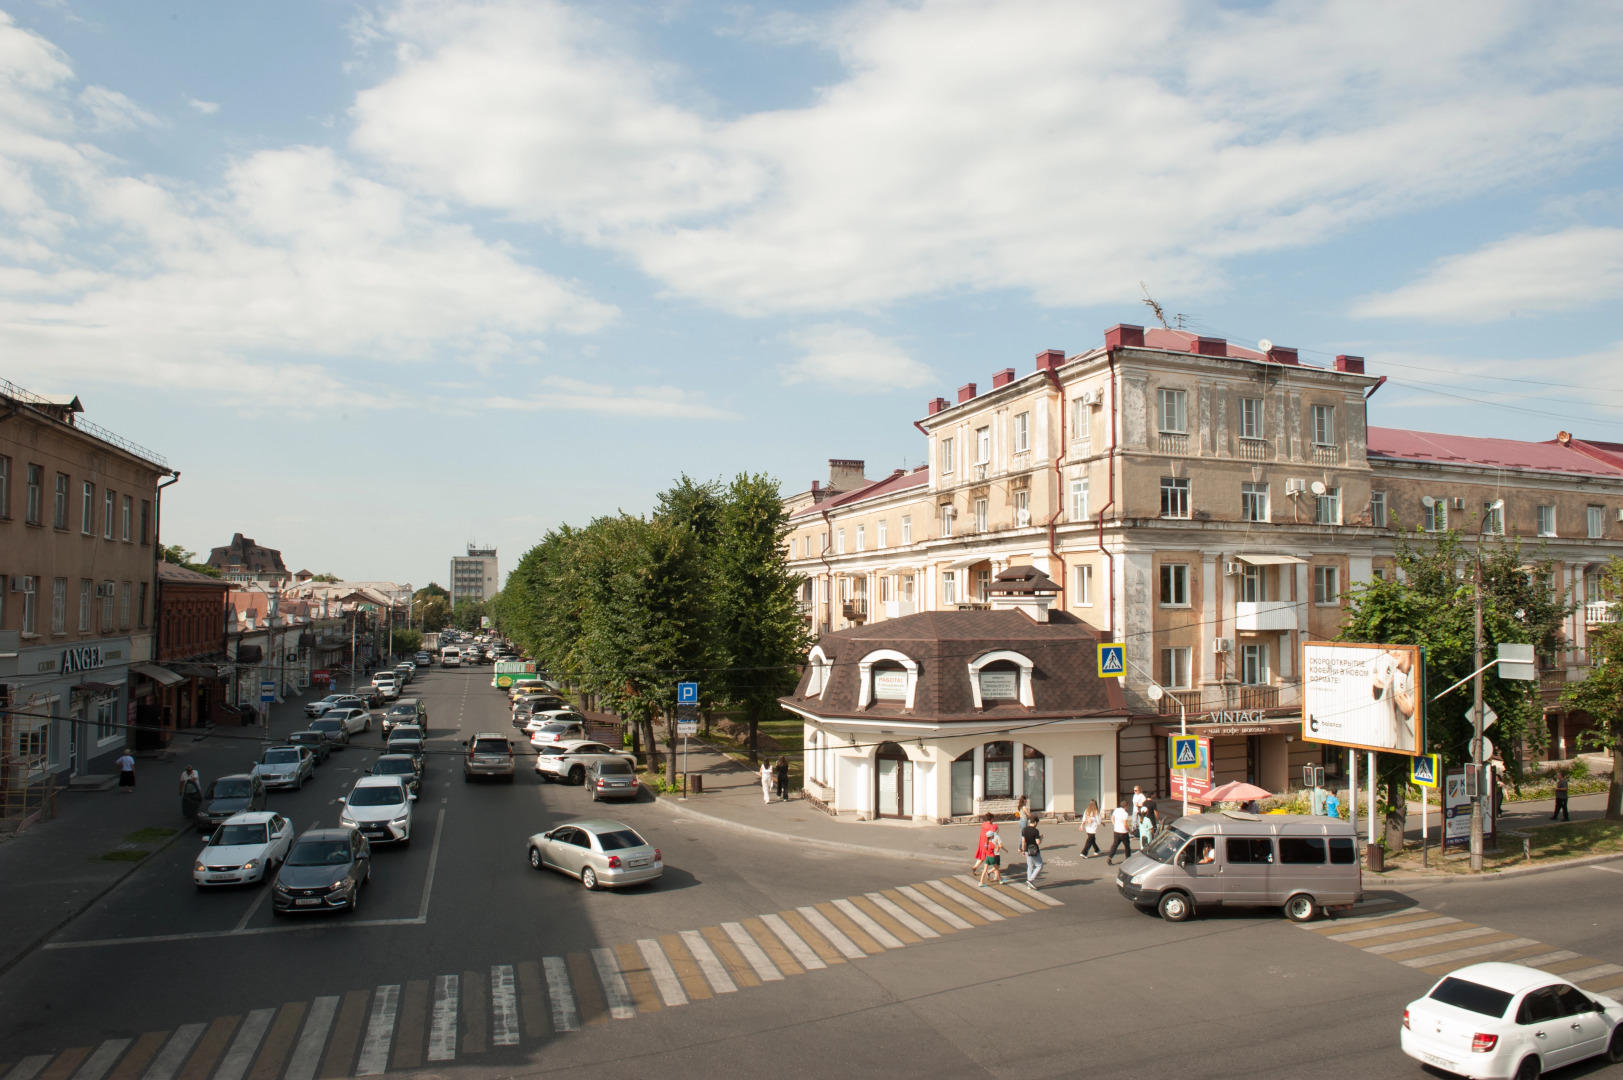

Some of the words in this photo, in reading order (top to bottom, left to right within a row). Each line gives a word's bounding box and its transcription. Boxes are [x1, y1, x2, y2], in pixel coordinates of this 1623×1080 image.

[62, 646, 104, 674] ANGEL
[1309, 657, 1329, 666] СКОРО
[1331, 658, 1366, 668] ОТКРЫТИЕ
[498, 663, 525, 674] ФИНИКИ
[525, 663, 536, 673] 95
[1309, 667, 1339, 675] КОФЕЙНИ
[1346, 669, 1370, 677] НОВОМ
[1210, 709, 1266, 724] VINTAGE
[1321, 720, 1343, 729] balance
[1222, 727, 1240, 735] кофе
